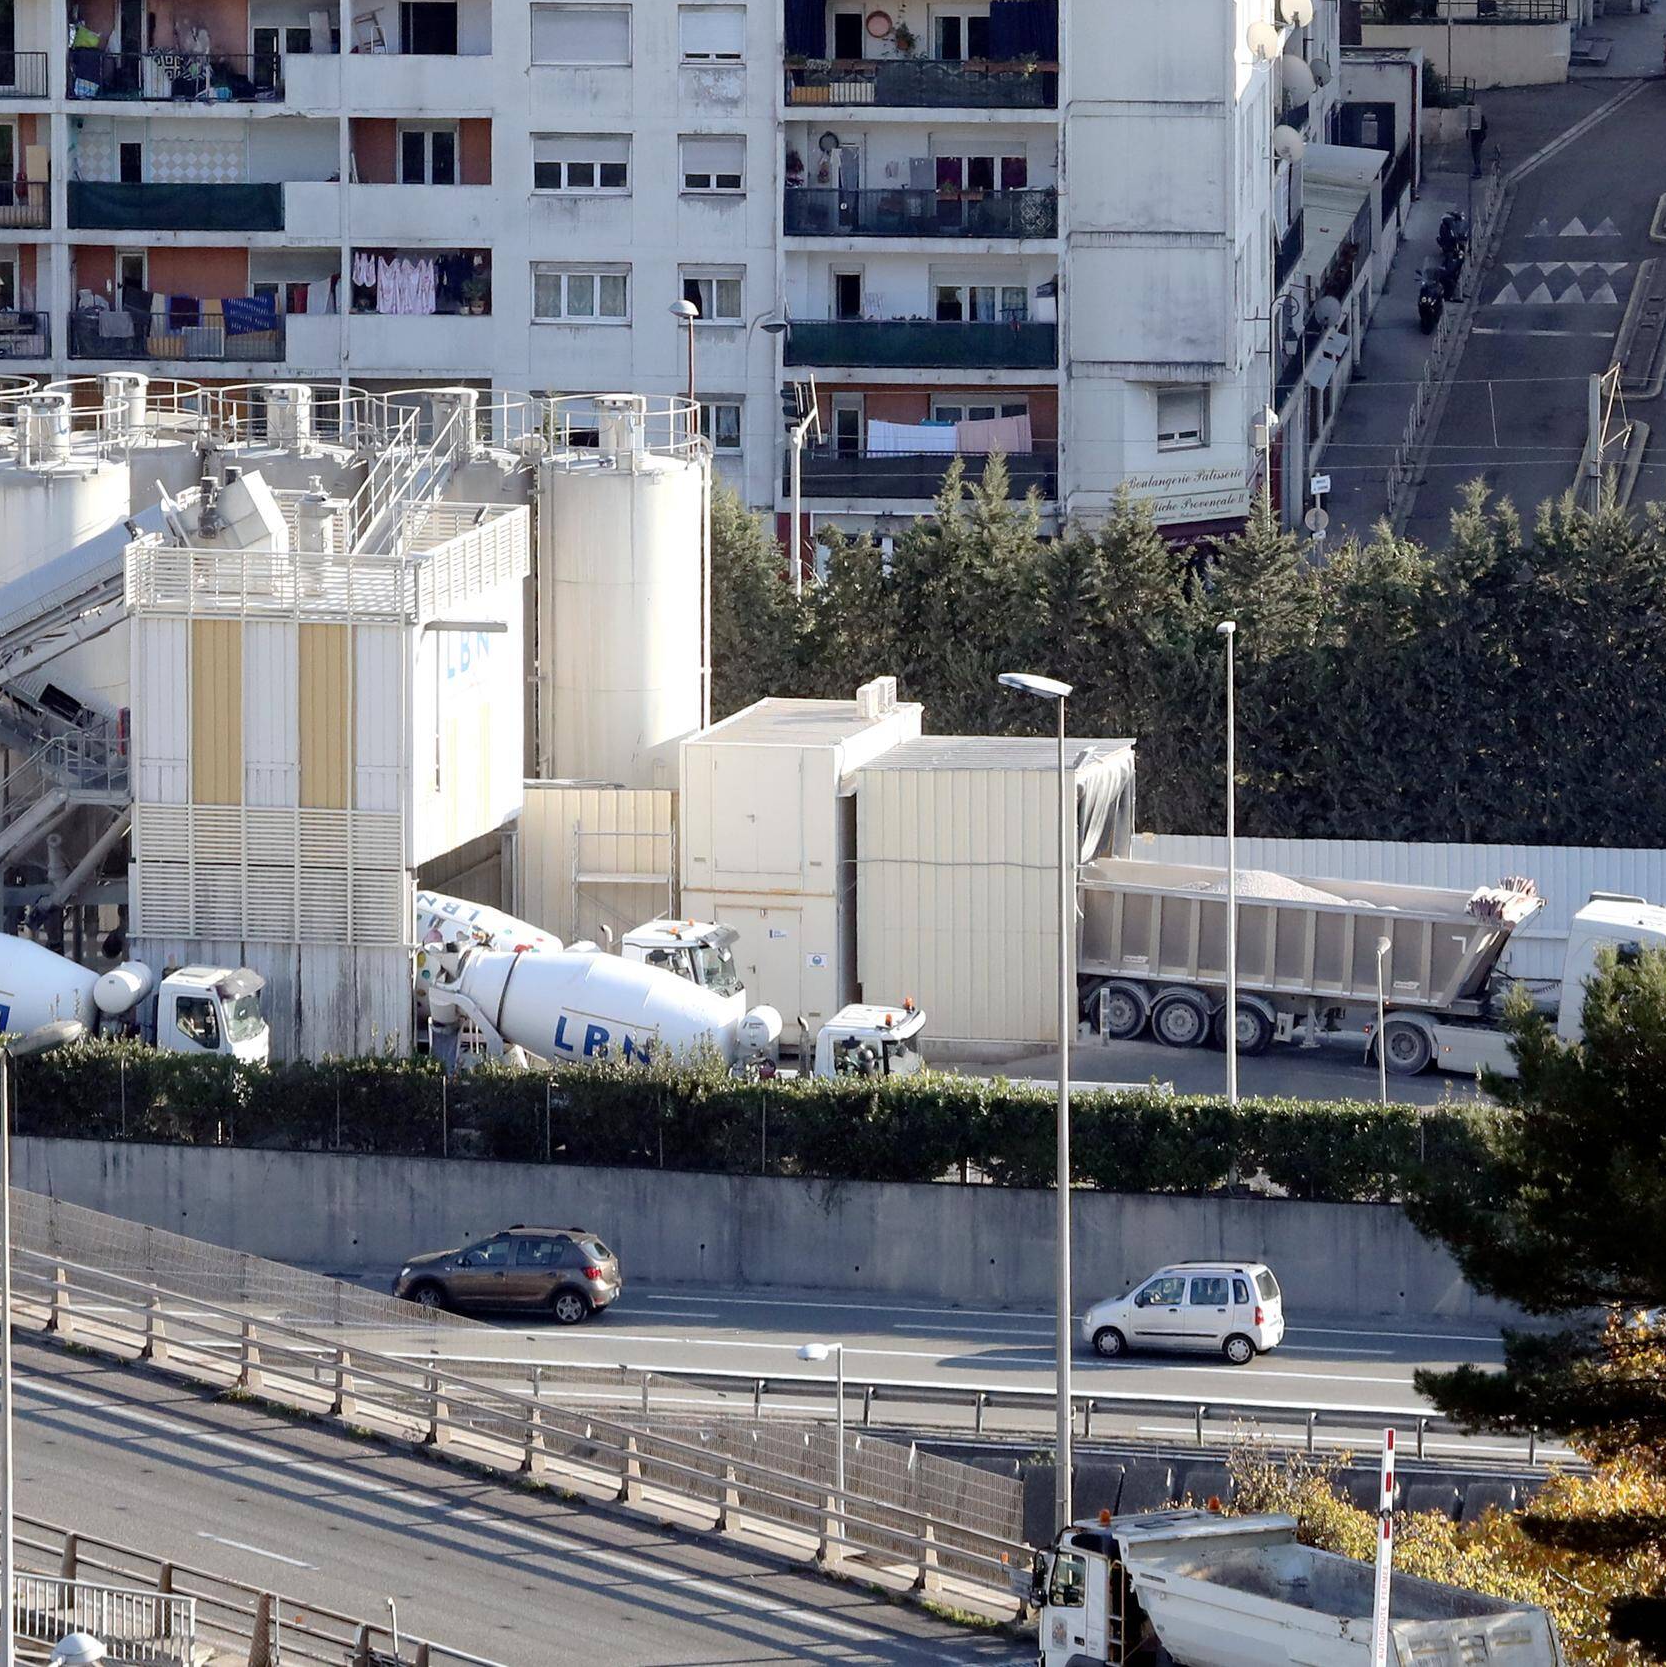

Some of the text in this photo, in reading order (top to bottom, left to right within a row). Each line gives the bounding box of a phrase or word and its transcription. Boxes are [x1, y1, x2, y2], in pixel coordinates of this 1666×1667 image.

[1128, 473, 1190, 490] Boulangerie
[554, 1015, 653, 1066] LBN
[1378, 1565, 1389, 1659] AUTOROUTE FERMEE
